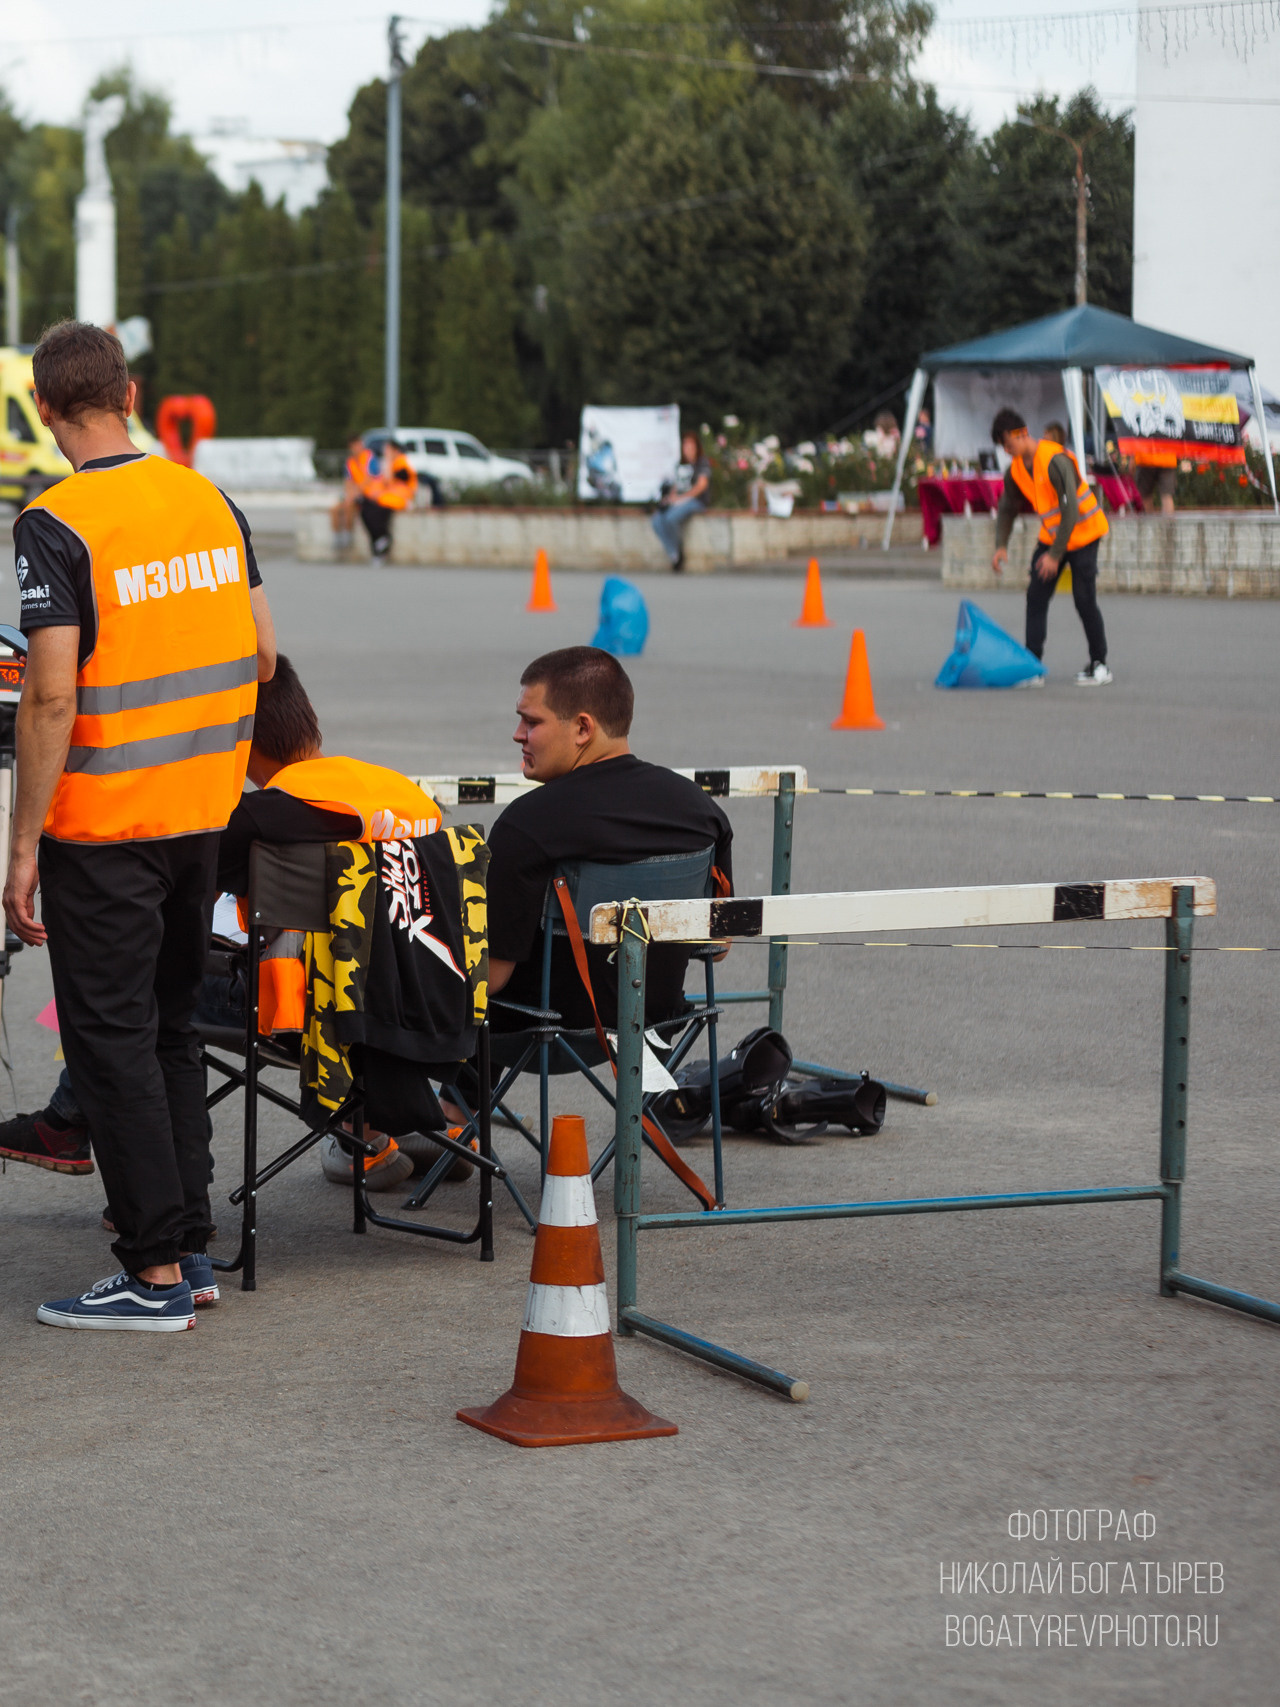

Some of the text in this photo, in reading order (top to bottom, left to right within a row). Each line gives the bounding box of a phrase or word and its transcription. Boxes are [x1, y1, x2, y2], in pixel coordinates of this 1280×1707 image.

[113, 546, 240, 606] МЗОЦМ
[20, 584, 50, 600] saki
[39, 601, 51, 609] roll
